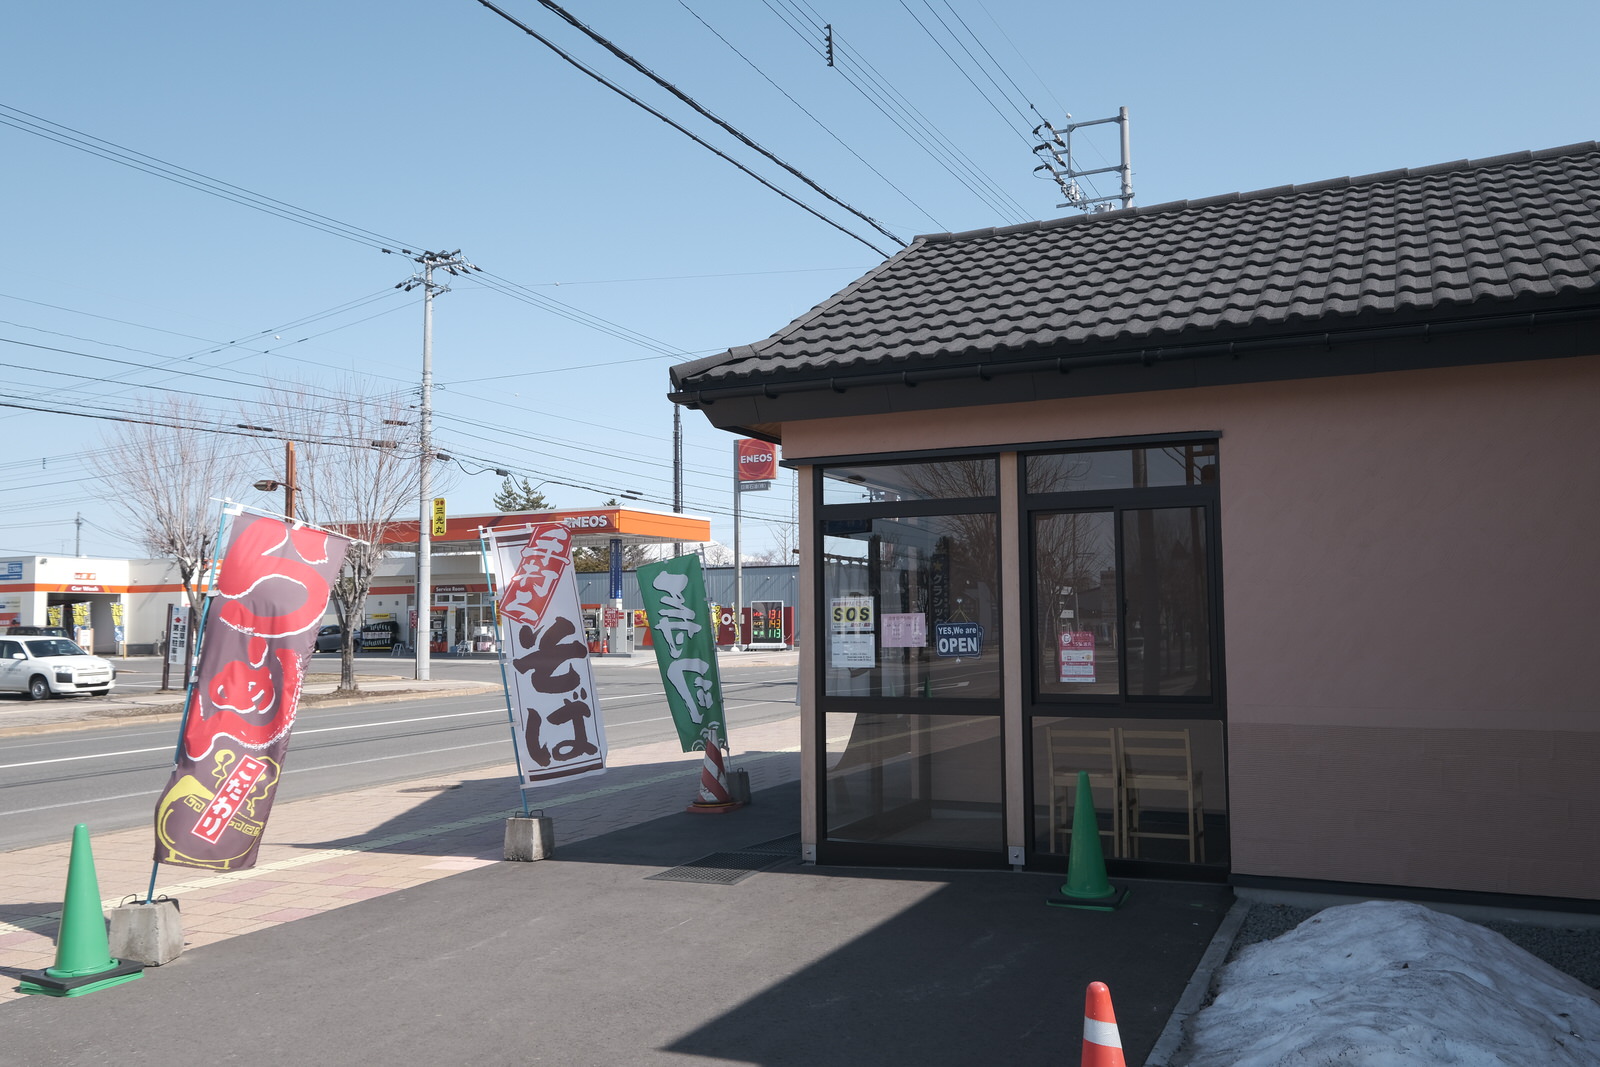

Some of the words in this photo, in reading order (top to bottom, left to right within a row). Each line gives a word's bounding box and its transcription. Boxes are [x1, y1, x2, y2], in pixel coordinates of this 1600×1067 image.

[740, 453, 773, 463] ENEOS
[436, 507, 445, 534] 三光丸
[505, 528, 571, 622] 手打ち
[768, 609, 781, 619] 131
[834, 607, 870, 623] SOS
[768, 619, 781, 628] 143
[768, 629, 781, 638] 113
[939, 637, 978, 653] OPEN
[513, 617, 599, 767] そば
[202, 762, 257, 836] こだわり
